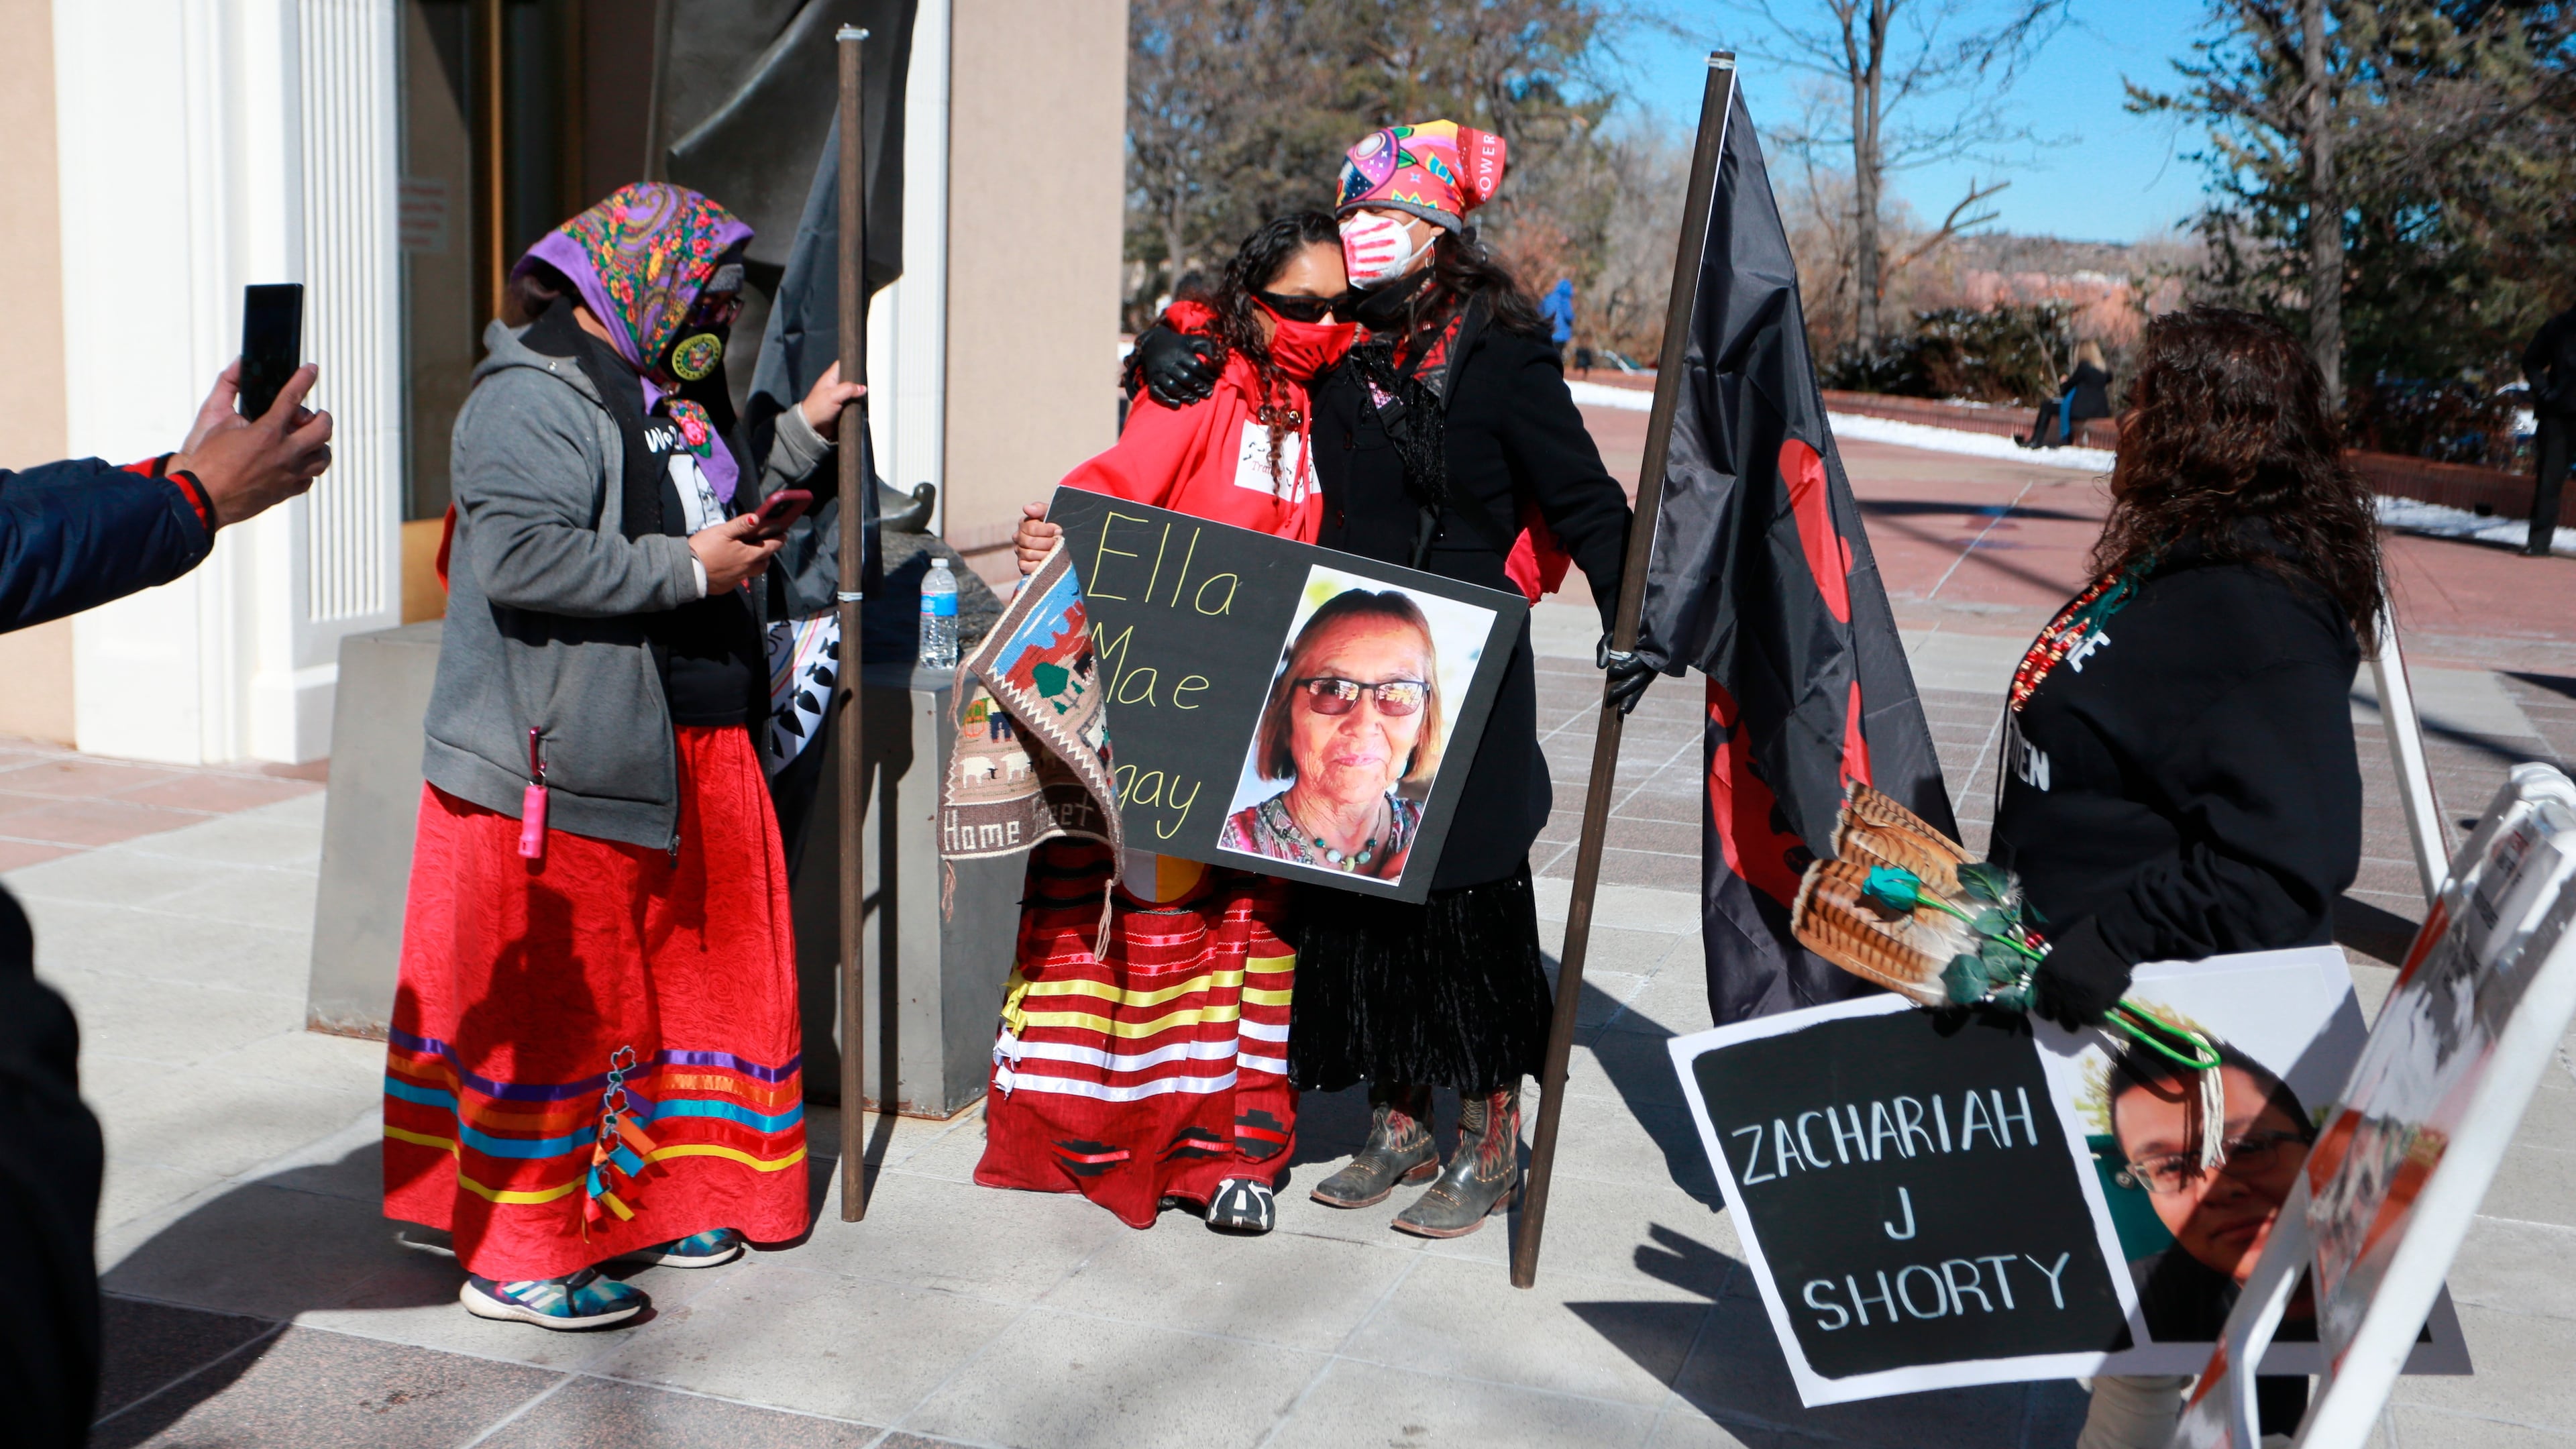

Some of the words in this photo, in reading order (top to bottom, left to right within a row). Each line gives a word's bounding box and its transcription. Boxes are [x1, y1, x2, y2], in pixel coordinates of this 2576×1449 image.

[1087, 511, 1238, 615] Ella
[1091, 621, 1209, 709] Mae
[944, 808, 1020, 851] Home
[1731, 1087, 2038, 1185] ZACHARIAH
[1884, 1187, 1916, 1240] J
[1803, 1252, 2070, 1331] SHORTY
